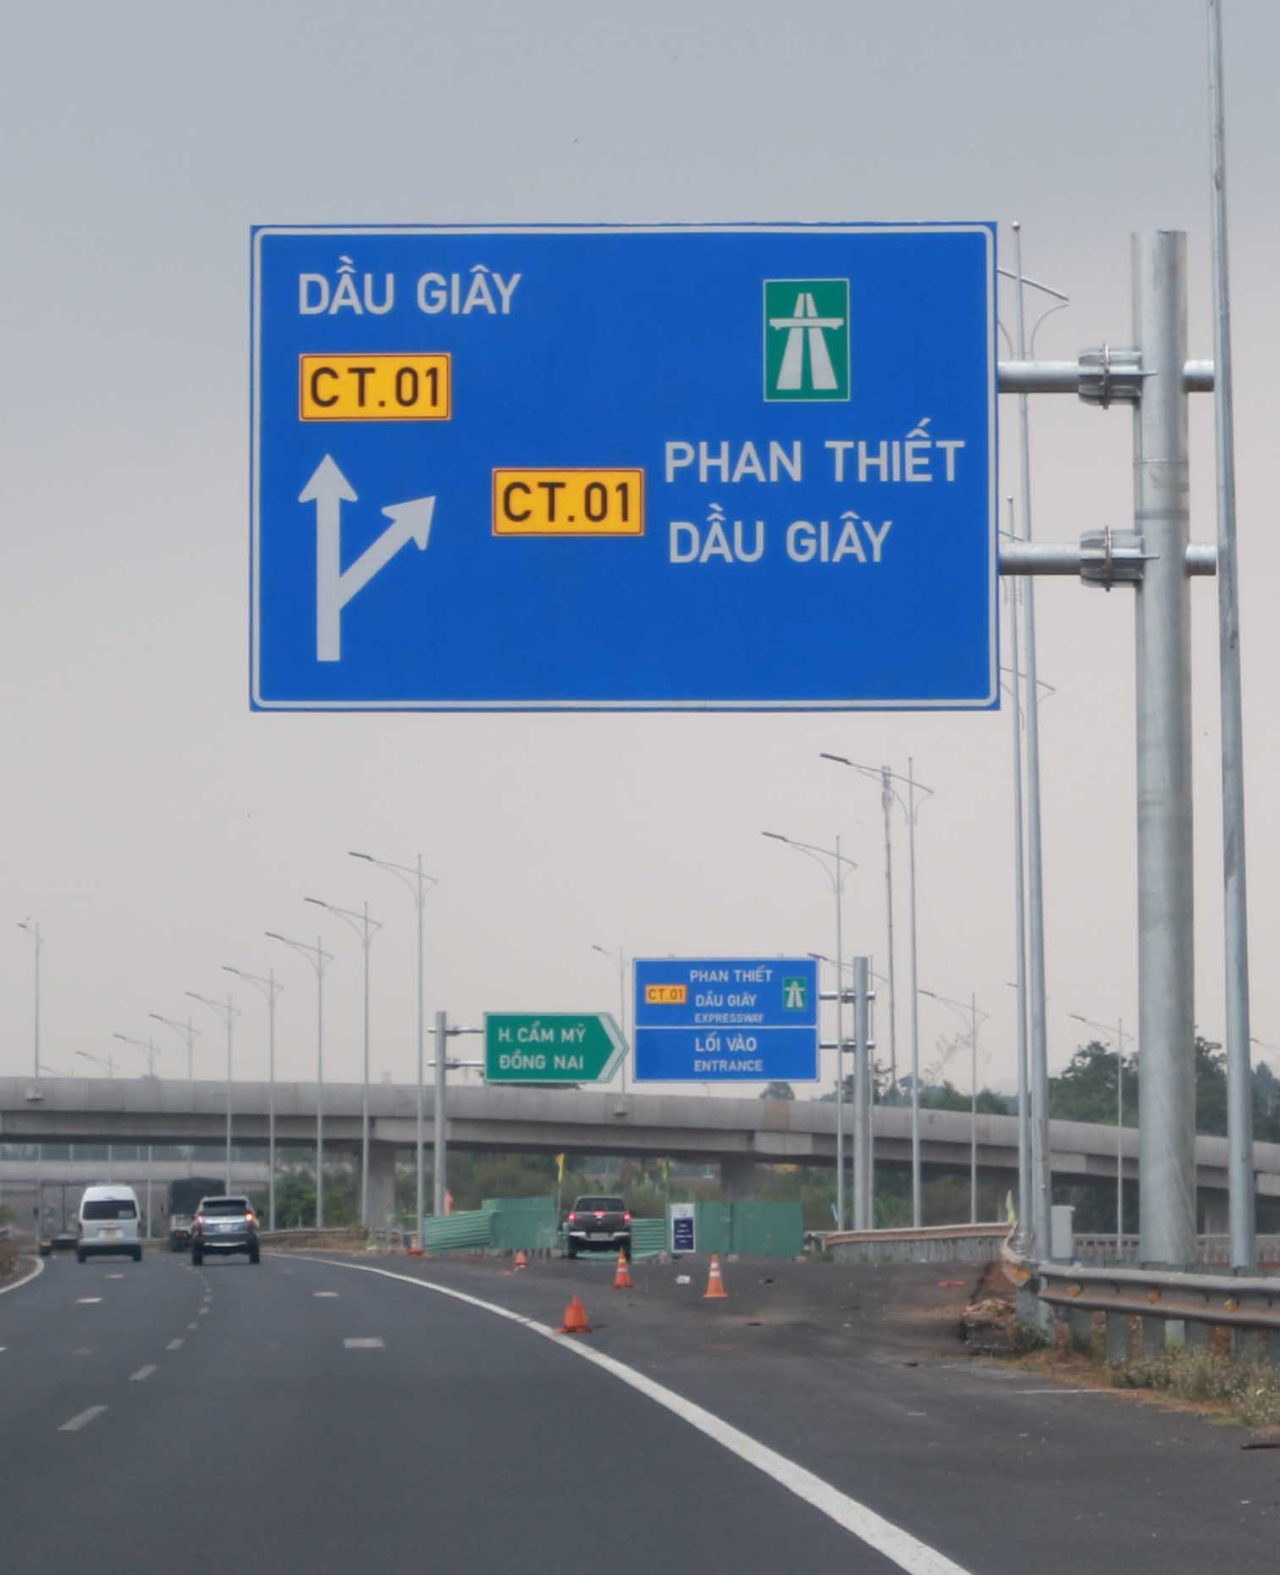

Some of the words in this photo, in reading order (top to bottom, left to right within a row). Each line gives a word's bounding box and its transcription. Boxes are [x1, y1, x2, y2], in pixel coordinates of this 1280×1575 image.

[298, 255, 395, 316] DẦU
[416, 263, 522, 315] GIÂY
[310, 366, 439, 408] CT.01
[664, 440, 803, 483] PHAN
[824, 417, 966, 483] THIẾT
[502, 481, 629, 523] CT.01
[669, 502, 765, 564] DẦU
[785, 510, 893, 563] GIÂY
[689, 969, 729, 983] PHAN
[733, 964, 773, 983] THIẾT
[694, 1012, 764, 1024] EXPRESSWAY
[694, 1031, 721, 1053] LỐI
[725, 1033, 758, 1052] VÀO
[553, 1055, 584, 1070] NAI
[693, 1059, 763, 1072] ENTRANCE
